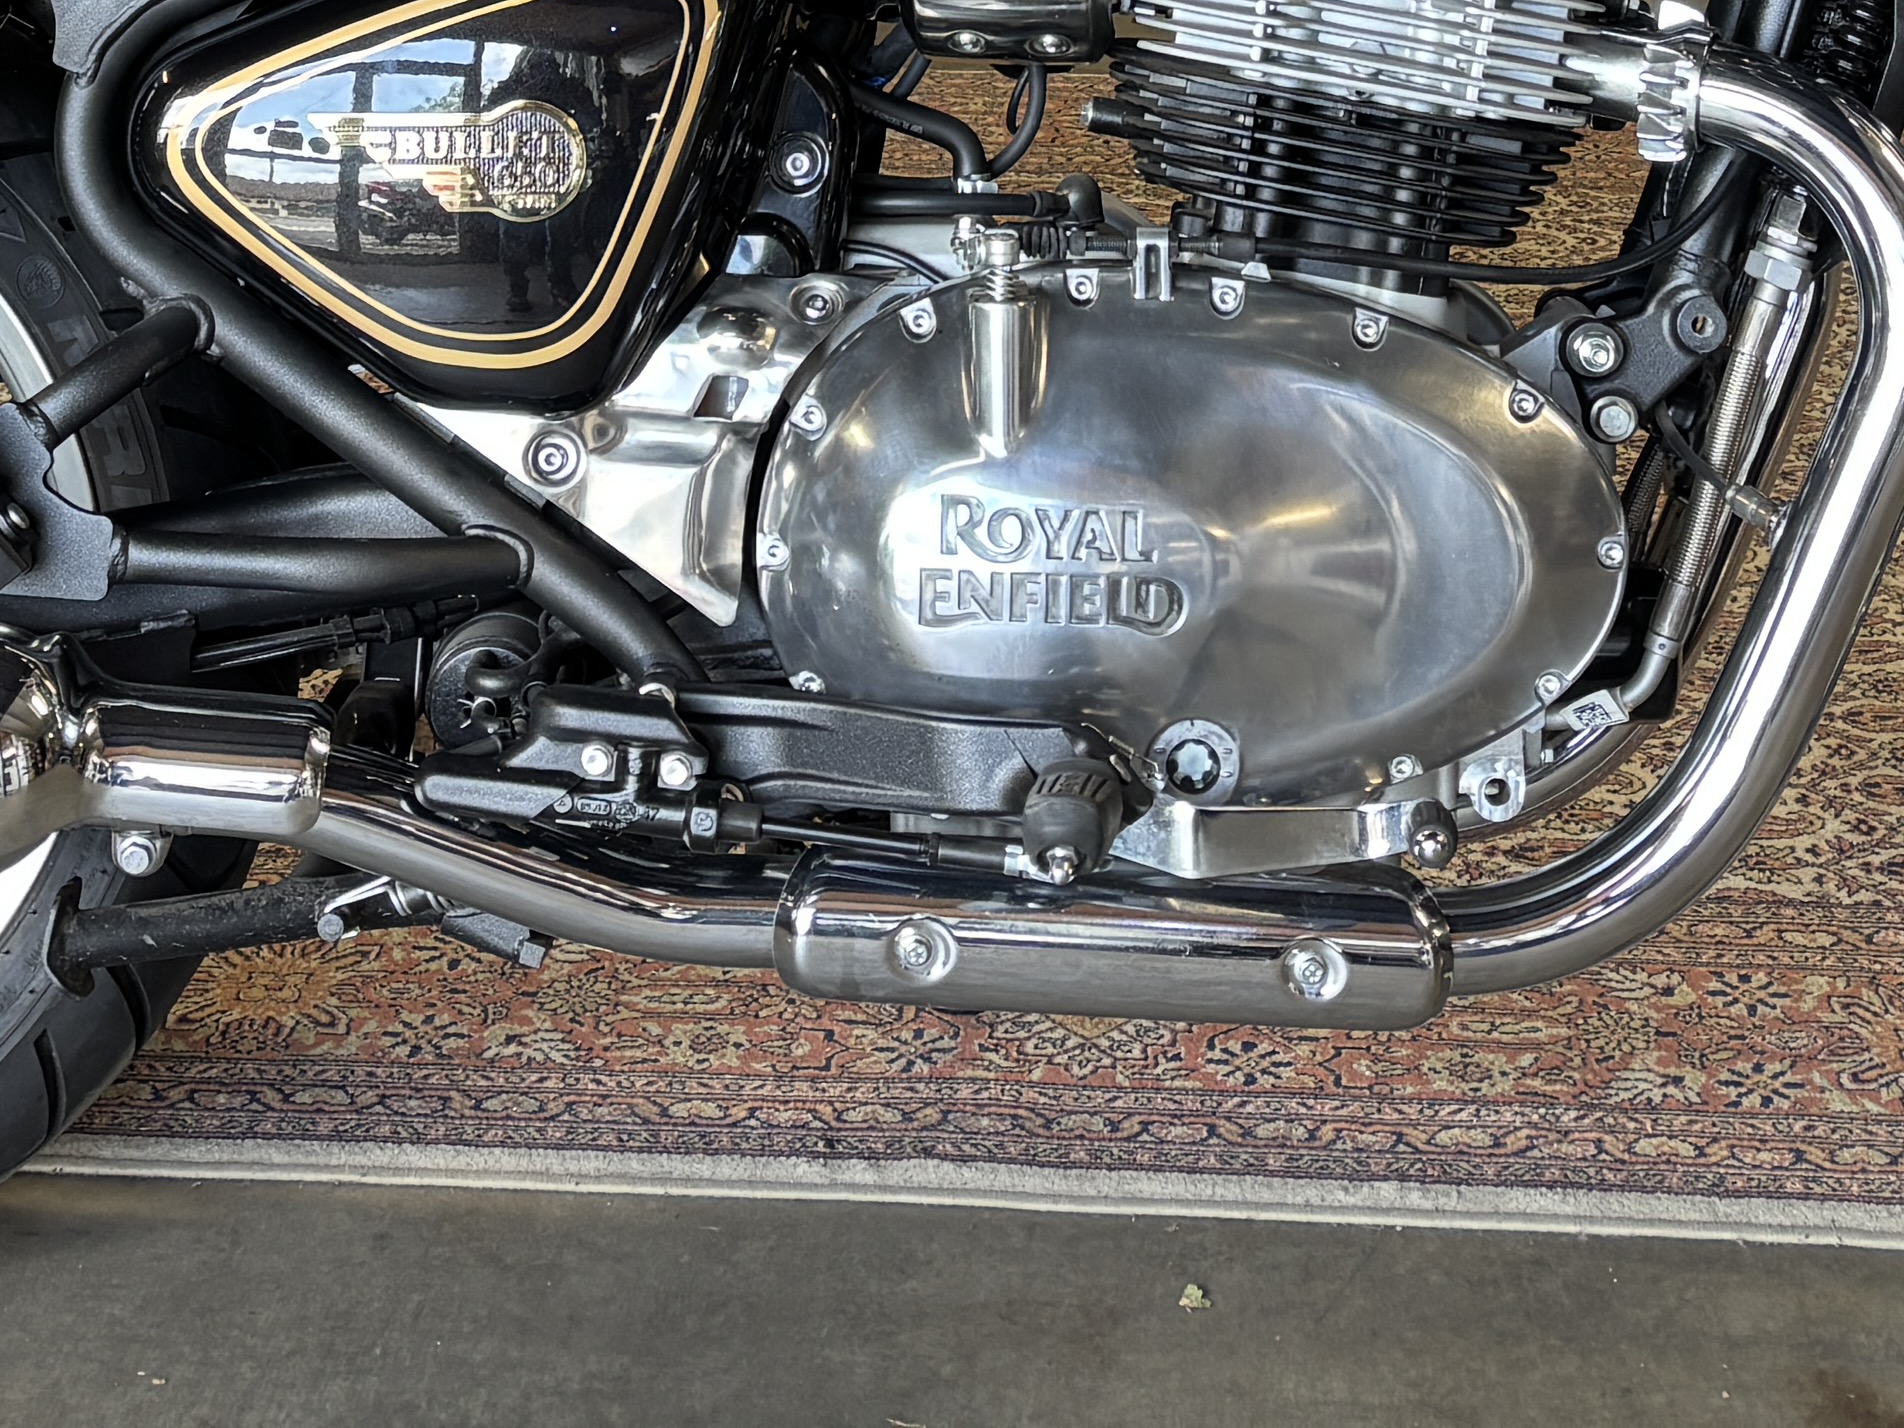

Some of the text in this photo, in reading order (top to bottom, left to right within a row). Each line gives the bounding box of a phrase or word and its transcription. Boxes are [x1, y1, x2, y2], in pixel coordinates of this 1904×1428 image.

[389, 130, 557, 159] BULLET
[939, 493, 1159, 565] ROYAL
[917, 566, 1190, 638] ENFIELD
